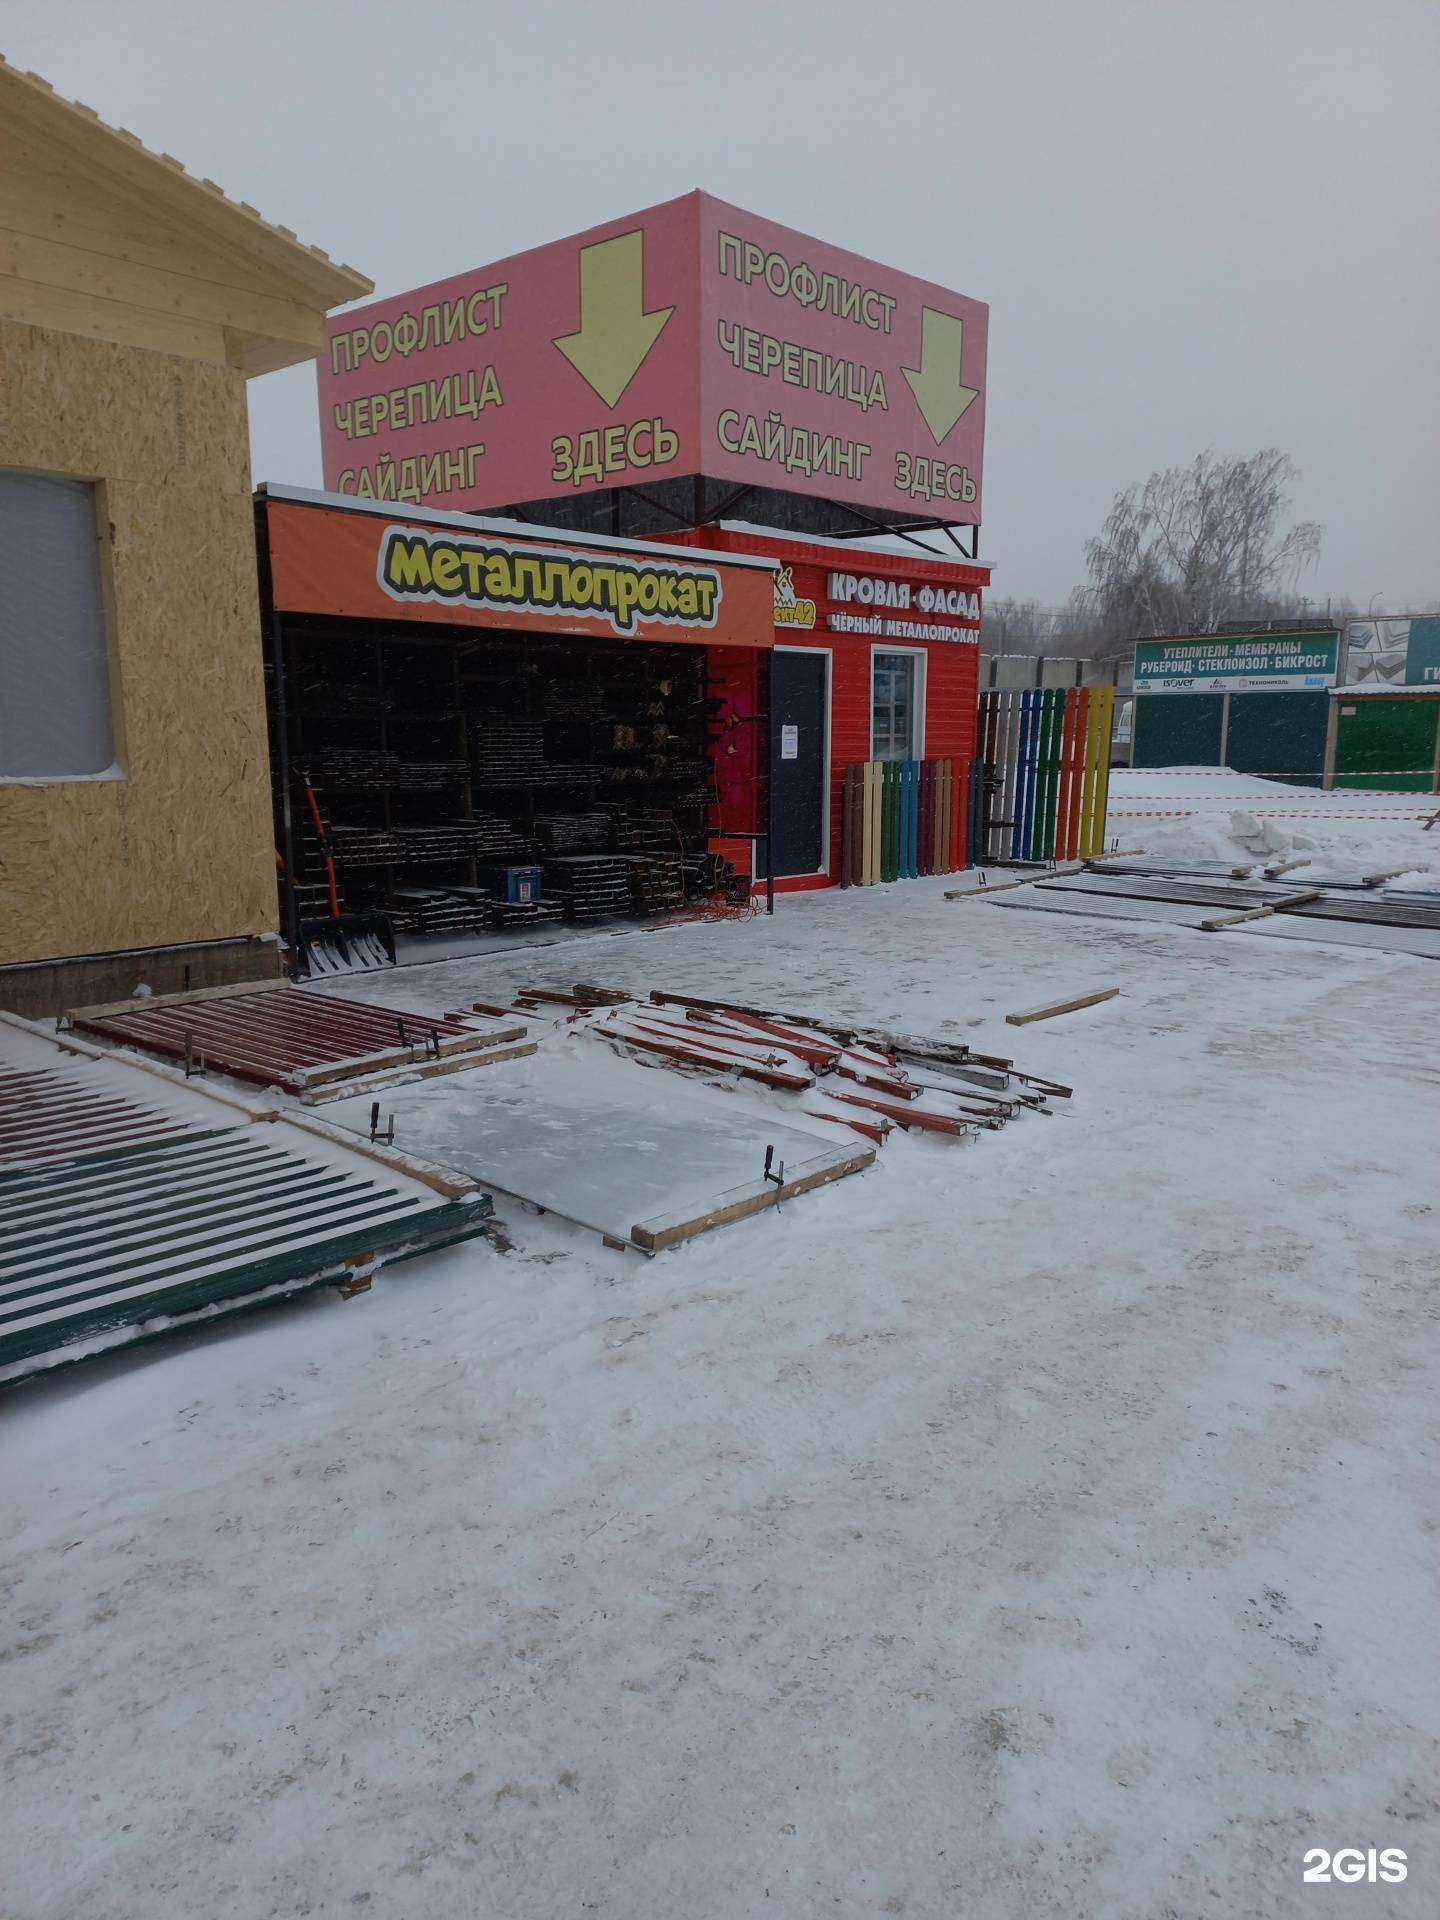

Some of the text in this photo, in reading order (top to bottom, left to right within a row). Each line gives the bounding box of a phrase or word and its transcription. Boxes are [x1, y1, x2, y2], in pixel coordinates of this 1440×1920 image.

[718, 230, 896, 334] ПРОФЛИСТ
[331, 282, 508, 374] ПРОФЛИСТ
[718, 318, 889, 412] ЧЕРЕПИЦА
[333, 365, 504, 440] ЧЕРЕПИЦА
[338, 443, 486, 504] САЙДИНГ
[551, 417, 680, 487] ЗДЕСЬ
[717, 408, 872, 481] САЙДИНГ
[895, 451, 977, 503] ЗДЕСЬ
[830, 612, 980, 644] ЧЁРНЫЙ МЕТАЛЛОПРОКАТ
[1163, 641, 1302, 659] УТЕПЛИТЕЛИ МЕМБРАНЫ
[1141, 655, 1328, 673] РУБЕРОИД СТЕКЛОИЗОЛ БИКРОСТ
